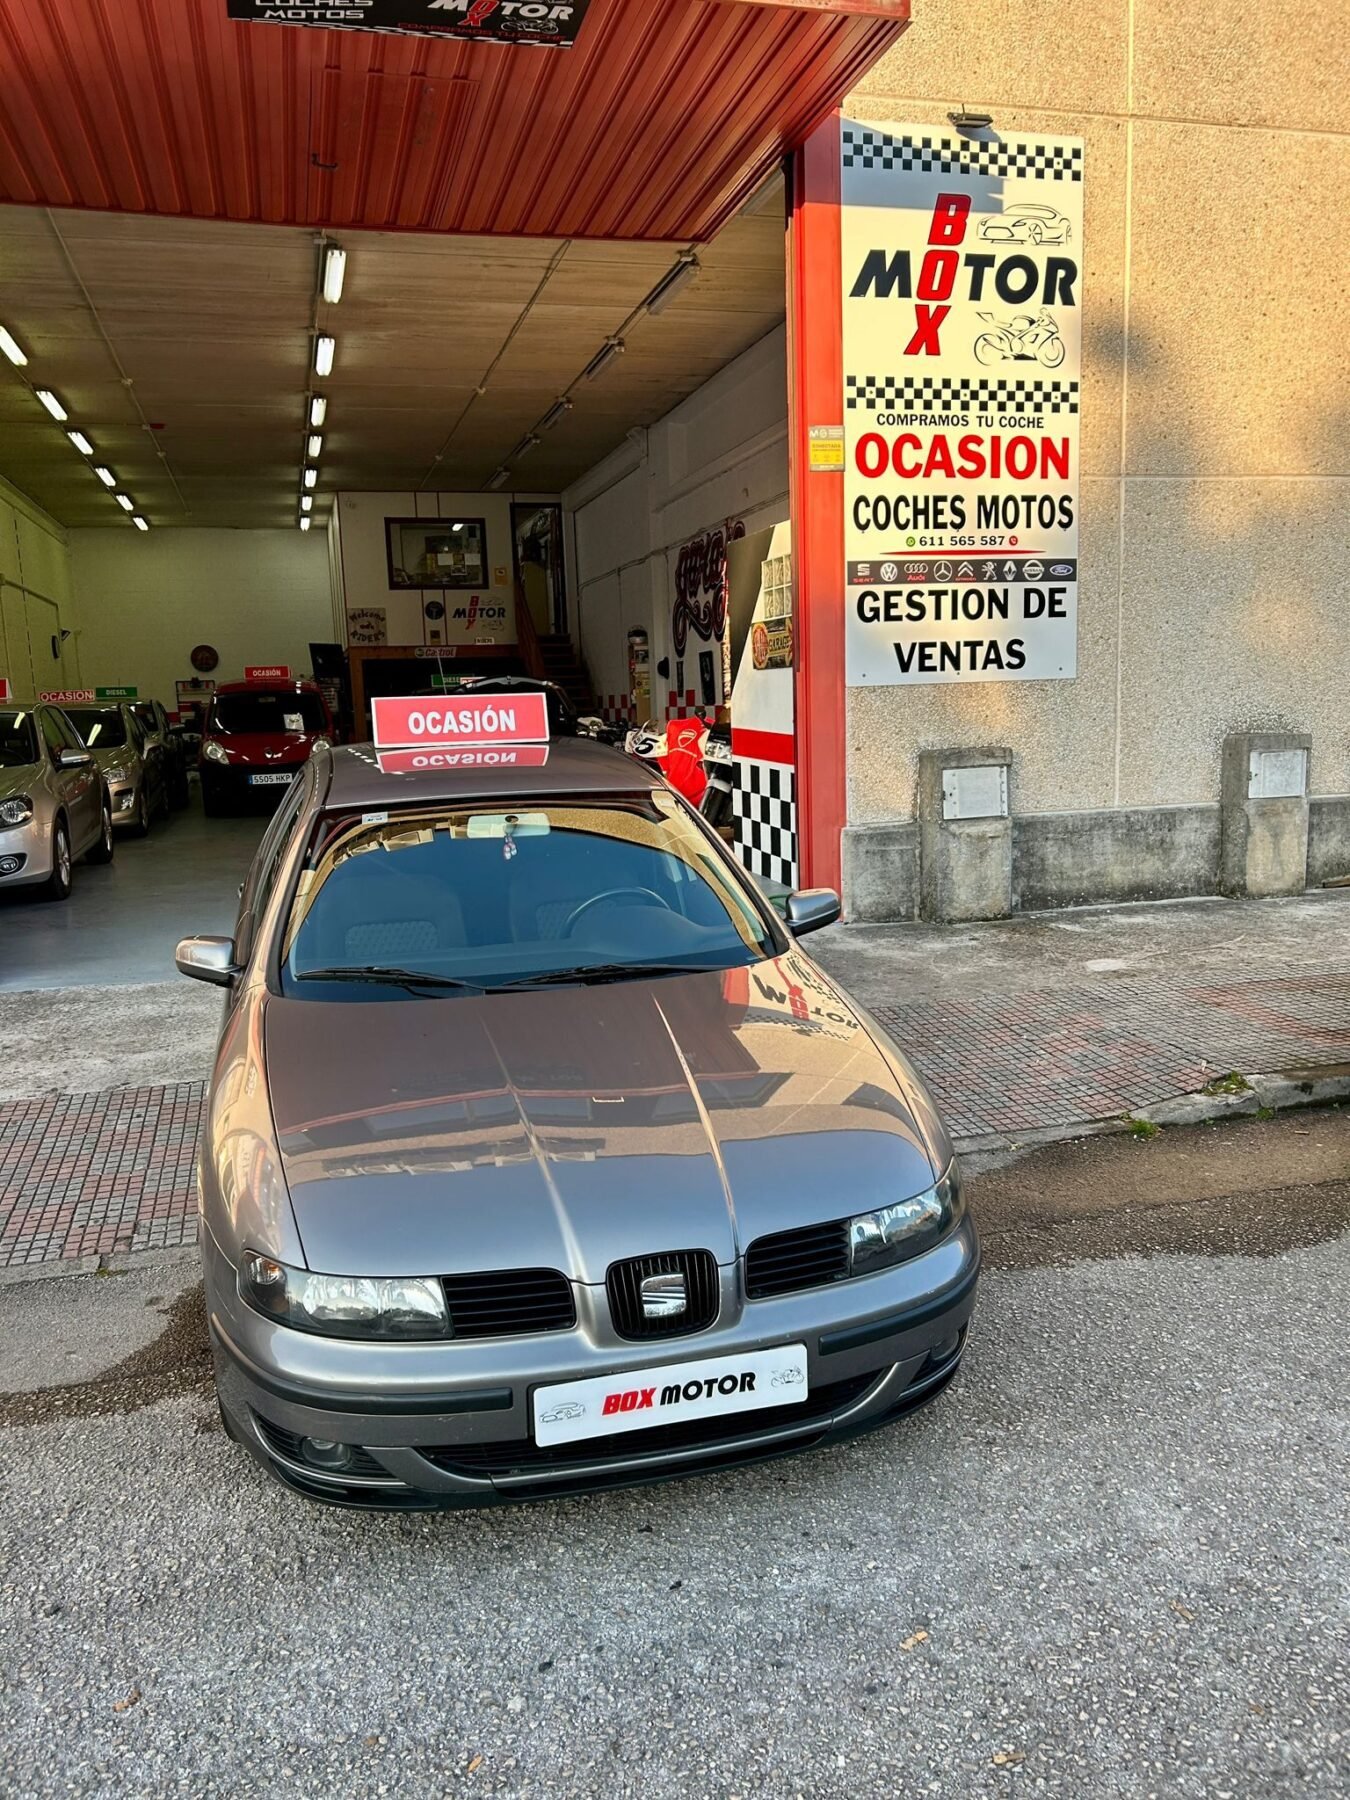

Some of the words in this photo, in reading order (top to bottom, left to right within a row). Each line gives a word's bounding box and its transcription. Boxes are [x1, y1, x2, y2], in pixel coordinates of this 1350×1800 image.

[264, 9, 364, 19] MOTOS
[849, 249, 1078, 306] MOTOR
[903, 193, 972, 356] BOX
[876, 413, 970, 427] COMPRAMOS
[976, 415, 994, 428] TU
[999, 416, 1044, 429] COCHE
[855, 432, 1070, 480] OCASION
[853, 494, 966, 531] COCHES
[977, 494, 1074, 530] MOTOS
[919, 536, 944, 547] 611
[950, 536, 975, 546] 565
[980, 535, 1005, 546] 587
[452, 607, 506, 619] MOTOR
[857, 588, 1009, 624] GESTION
[1023, 587, 1067, 619] DE
[893, 639, 1027, 673] VENTAS
[252, 668, 281, 678] OCASIÓN
[105, 688, 127, 696] DIESEL
[408, 704, 517, 735] OCASIÓN
[254, 775, 274, 784] 5505
[276, 774, 290, 782] HKP
[602, 1387, 657, 1416] BOX
[659, 1371, 756, 1406] MOTOR
